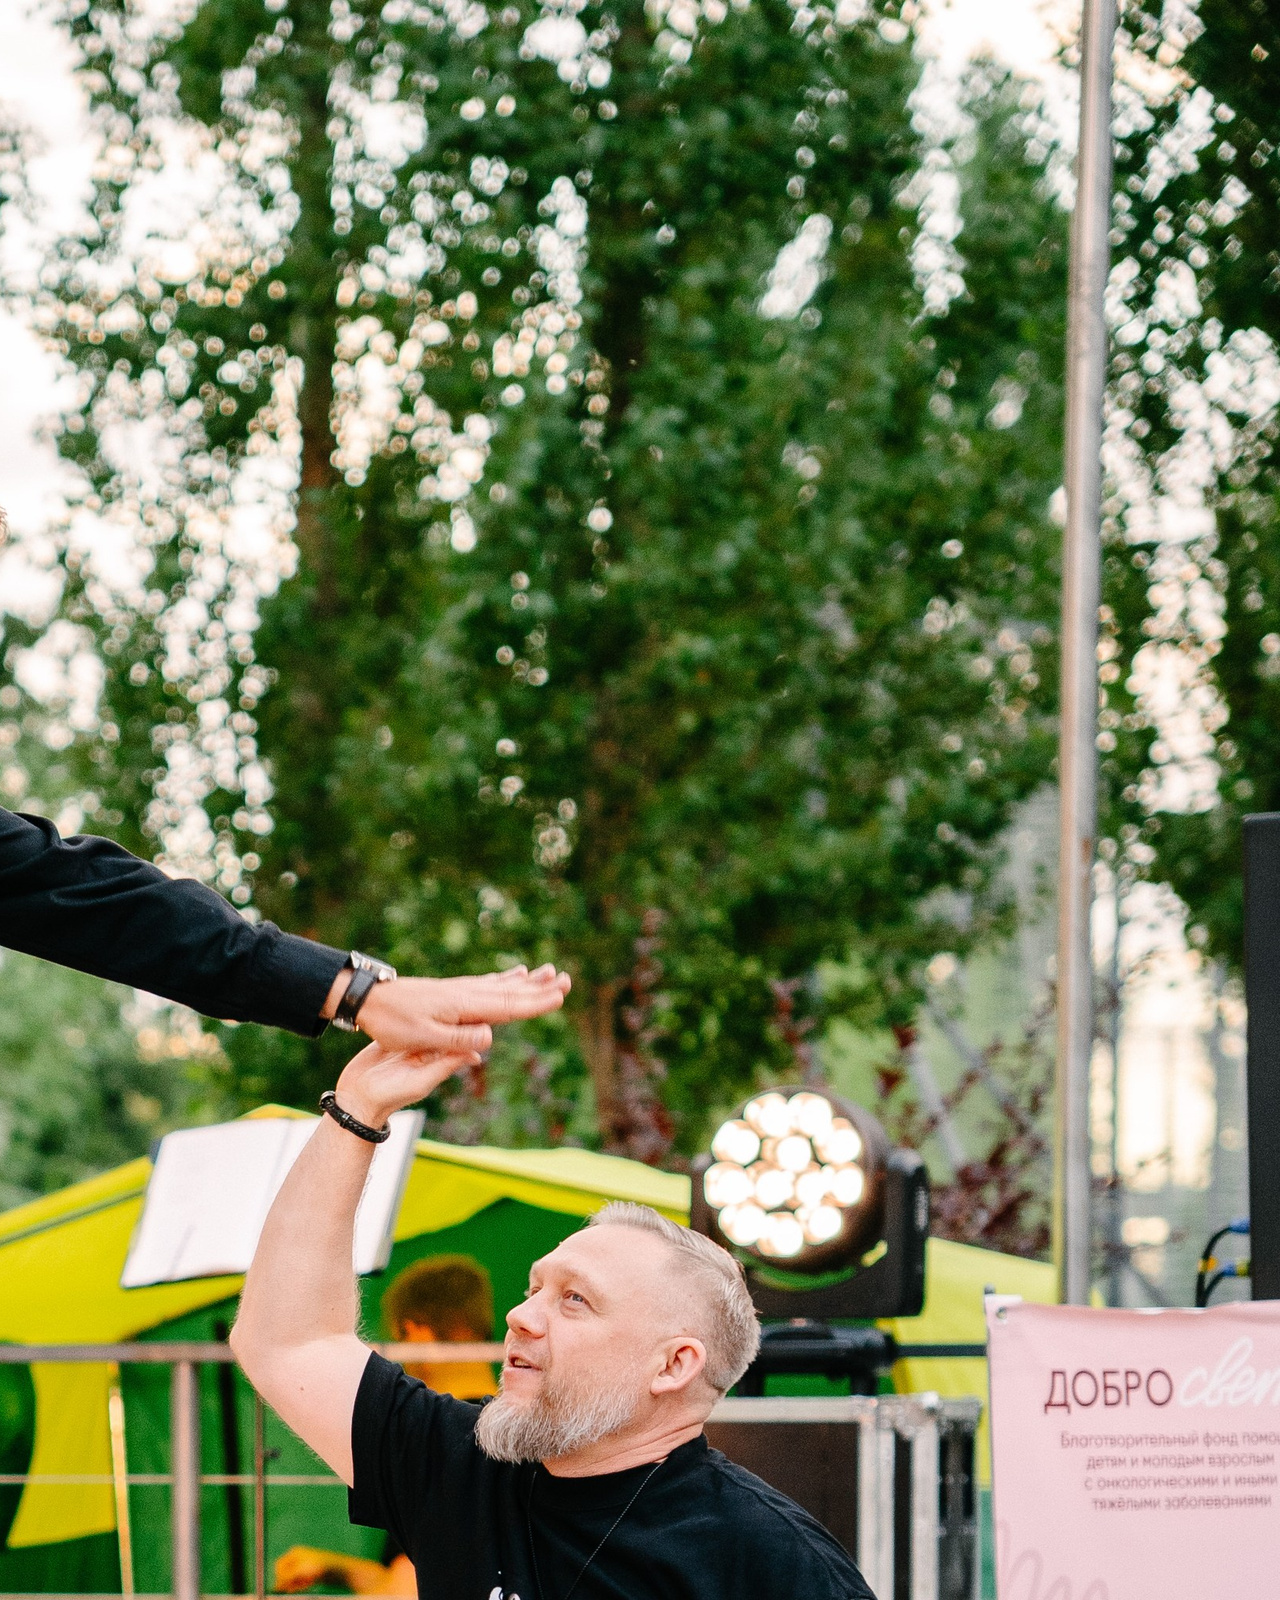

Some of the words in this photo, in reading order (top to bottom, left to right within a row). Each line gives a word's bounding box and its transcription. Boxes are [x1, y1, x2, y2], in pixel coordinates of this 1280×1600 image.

[1060, 1430, 1199, 1449] Благотворительный
[1202, 1430, 1239, 1449] фонд
[1086, 1455, 1126, 1471] детям
[1130, 1456, 1139, 1468] и
[1142, 1454, 1205, 1469] молодым
[1208, 1452, 1275, 1469] взрослым
[1096, 1475, 1218, 1491] онкологическими
[1222, 1475, 1230, 1487] и
[1234, 1474, 1279, 1487] иными
[1164, 1494, 1273, 1511] заболеваниями
